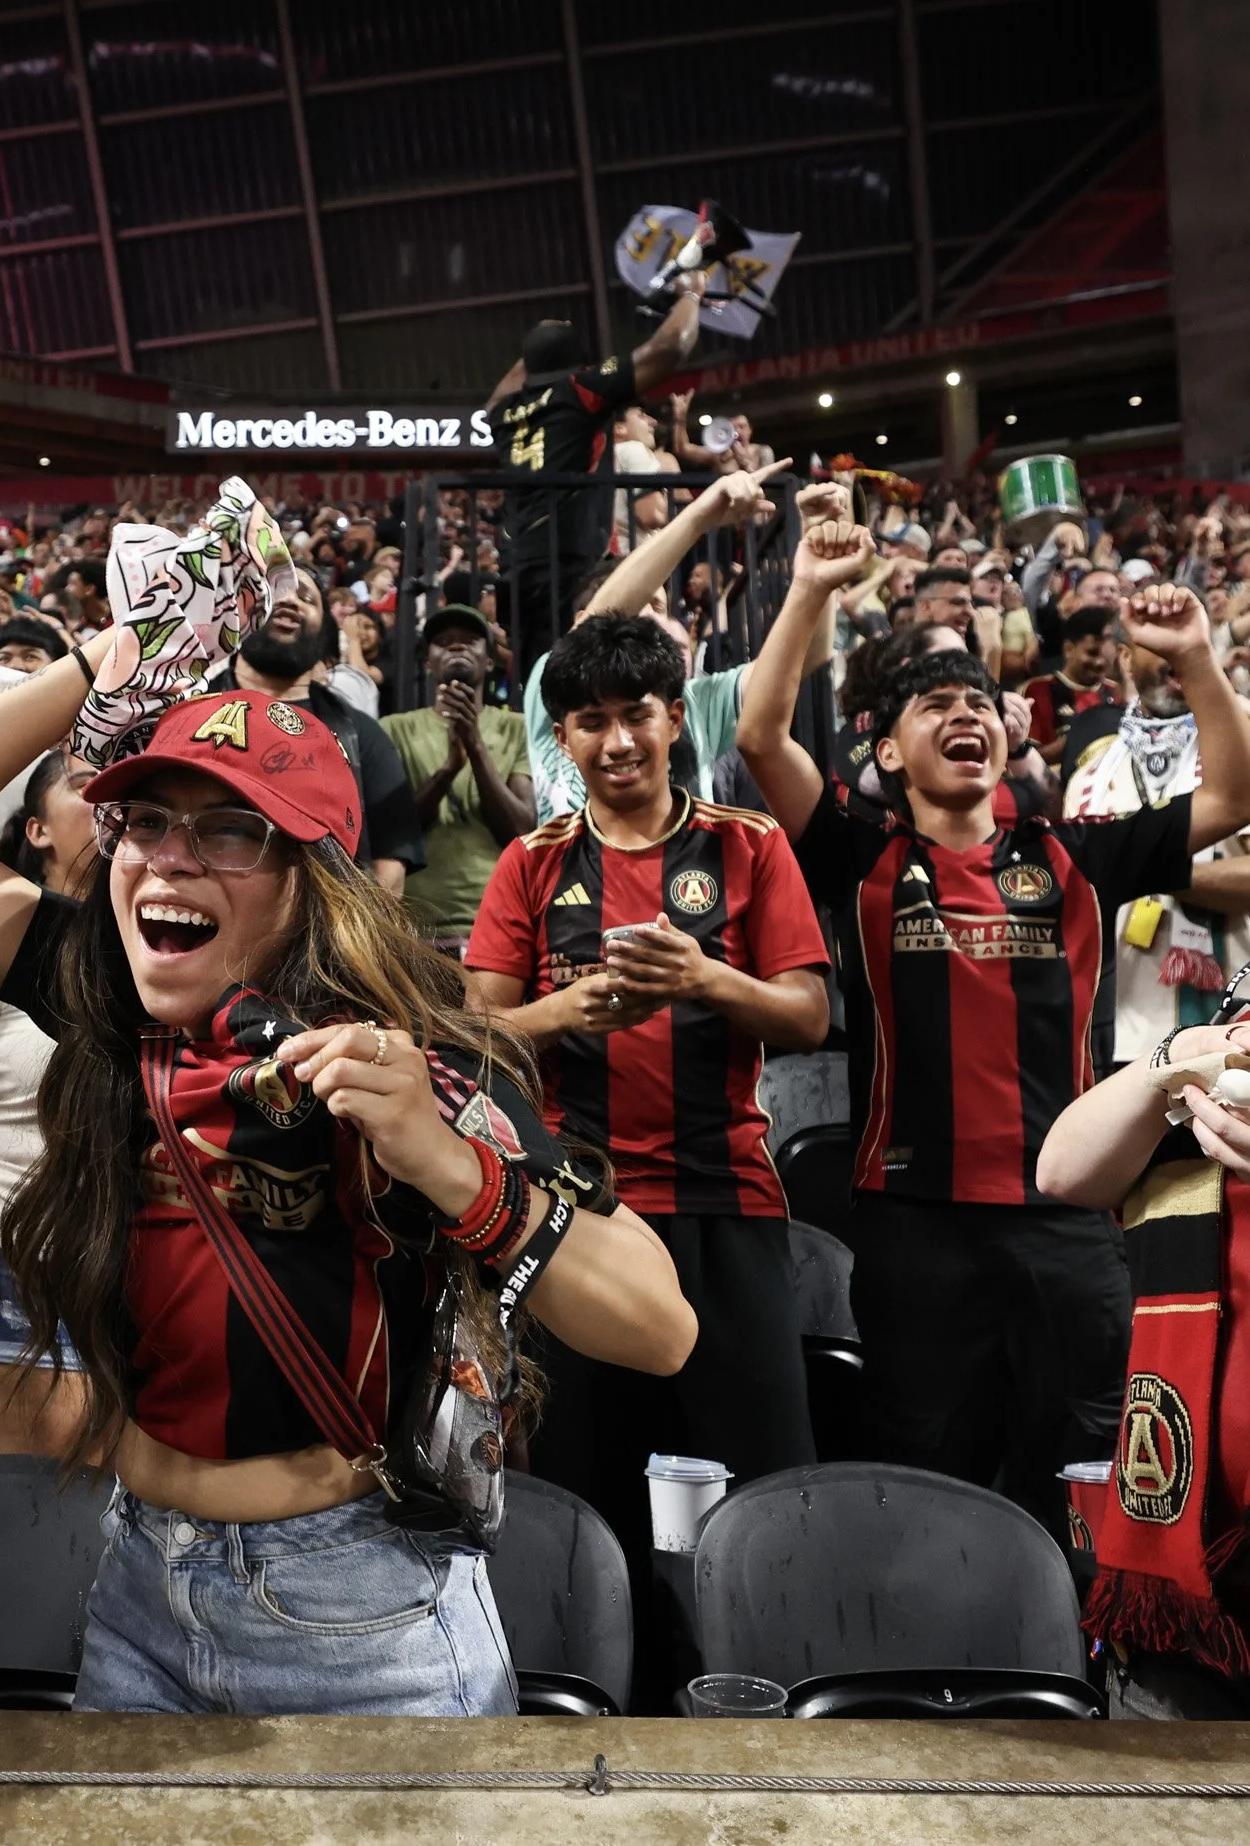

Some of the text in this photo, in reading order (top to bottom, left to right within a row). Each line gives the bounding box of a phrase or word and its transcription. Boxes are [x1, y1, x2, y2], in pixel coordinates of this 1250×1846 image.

[175, 410, 495, 449] Mercedes-Benz S
[510, 424, 545, 472] 4
[113, 473, 299, 504] WELCME
[992, 924, 1054, 943] FAMILY
[462, 1110, 484, 1136] MLS
[508, 1255, 540, 1293] THE
[943, 1688, 953, 1702] 9
